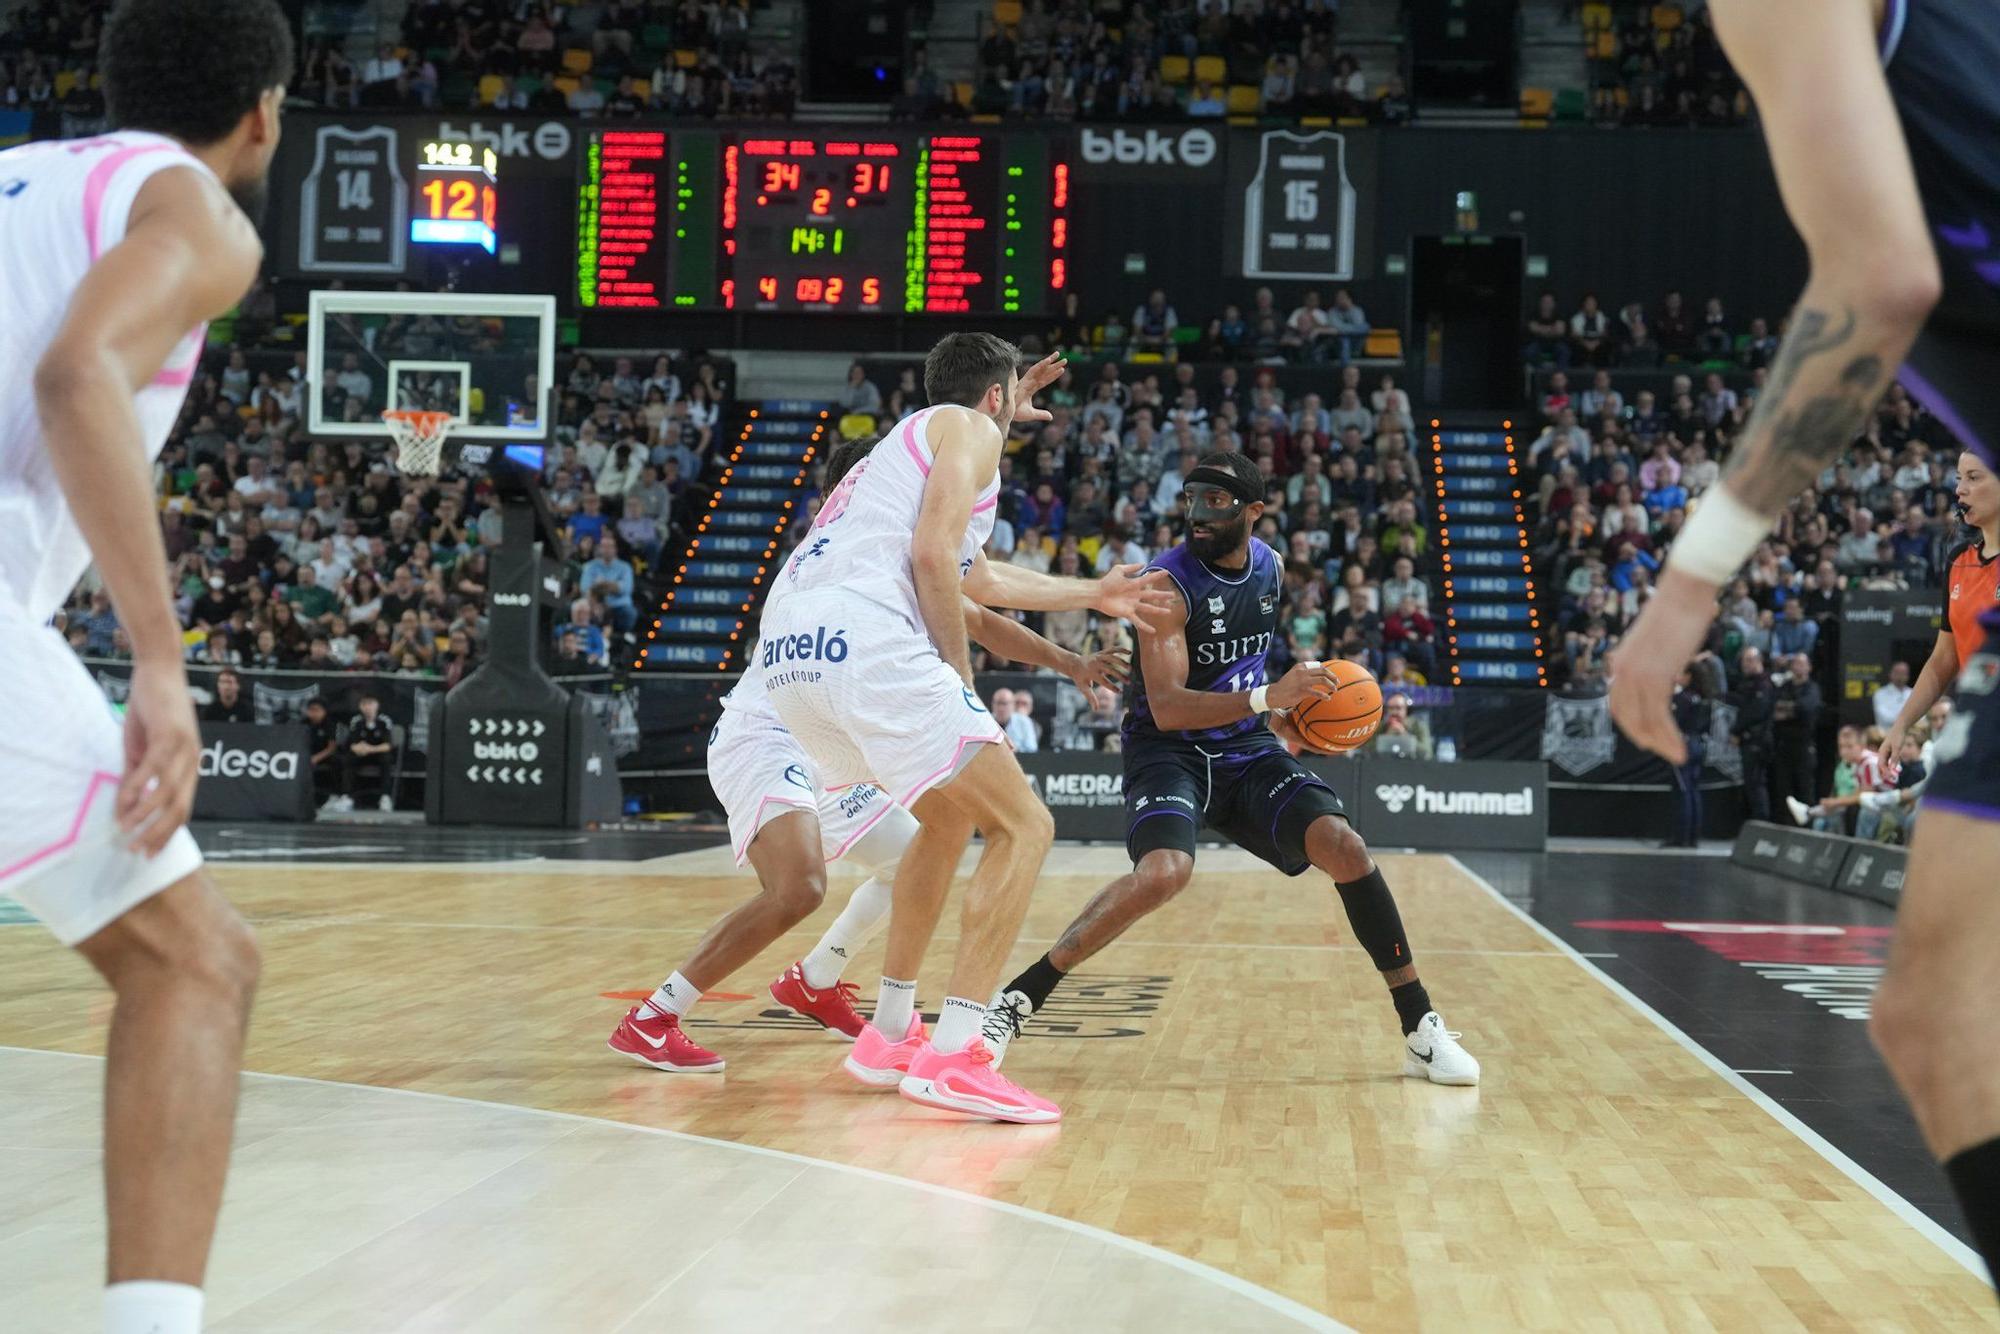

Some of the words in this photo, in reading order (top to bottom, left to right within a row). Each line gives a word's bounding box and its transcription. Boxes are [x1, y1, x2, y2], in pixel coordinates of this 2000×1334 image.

[1081, 128, 1176, 163] bbk
[337, 169, 374, 210] 14
[763, 161, 800, 193] 34
[853, 162, 890, 194] 31
[422, 178, 476, 220] 12
[812, 188, 831, 215] 2
[1283, 180, 1318, 221] 15
[759, 277, 777, 302] 4
[825, 277, 843, 304] 2
[862, 277, 880, 304] 5
[693, 589, 730, 604] IMQ
[1470, 578, 1507, 592] IMQ
[680, 617, 717, 632] IMQ
[1470, 605, 1508, 620] IMQ
[667, 647, 705, 662] IMQ
[763, 626, 848, 669] arceló
[1197, 626, 1275, 665] surn
[1476, 634, 1515, 650] IMQ
[1477, 663, 1518, 678] IMQ
[474, 741, 520, 762] bbk
[847, 801, 863, 818] del
[1415, 784, 1534, 816] hummel
